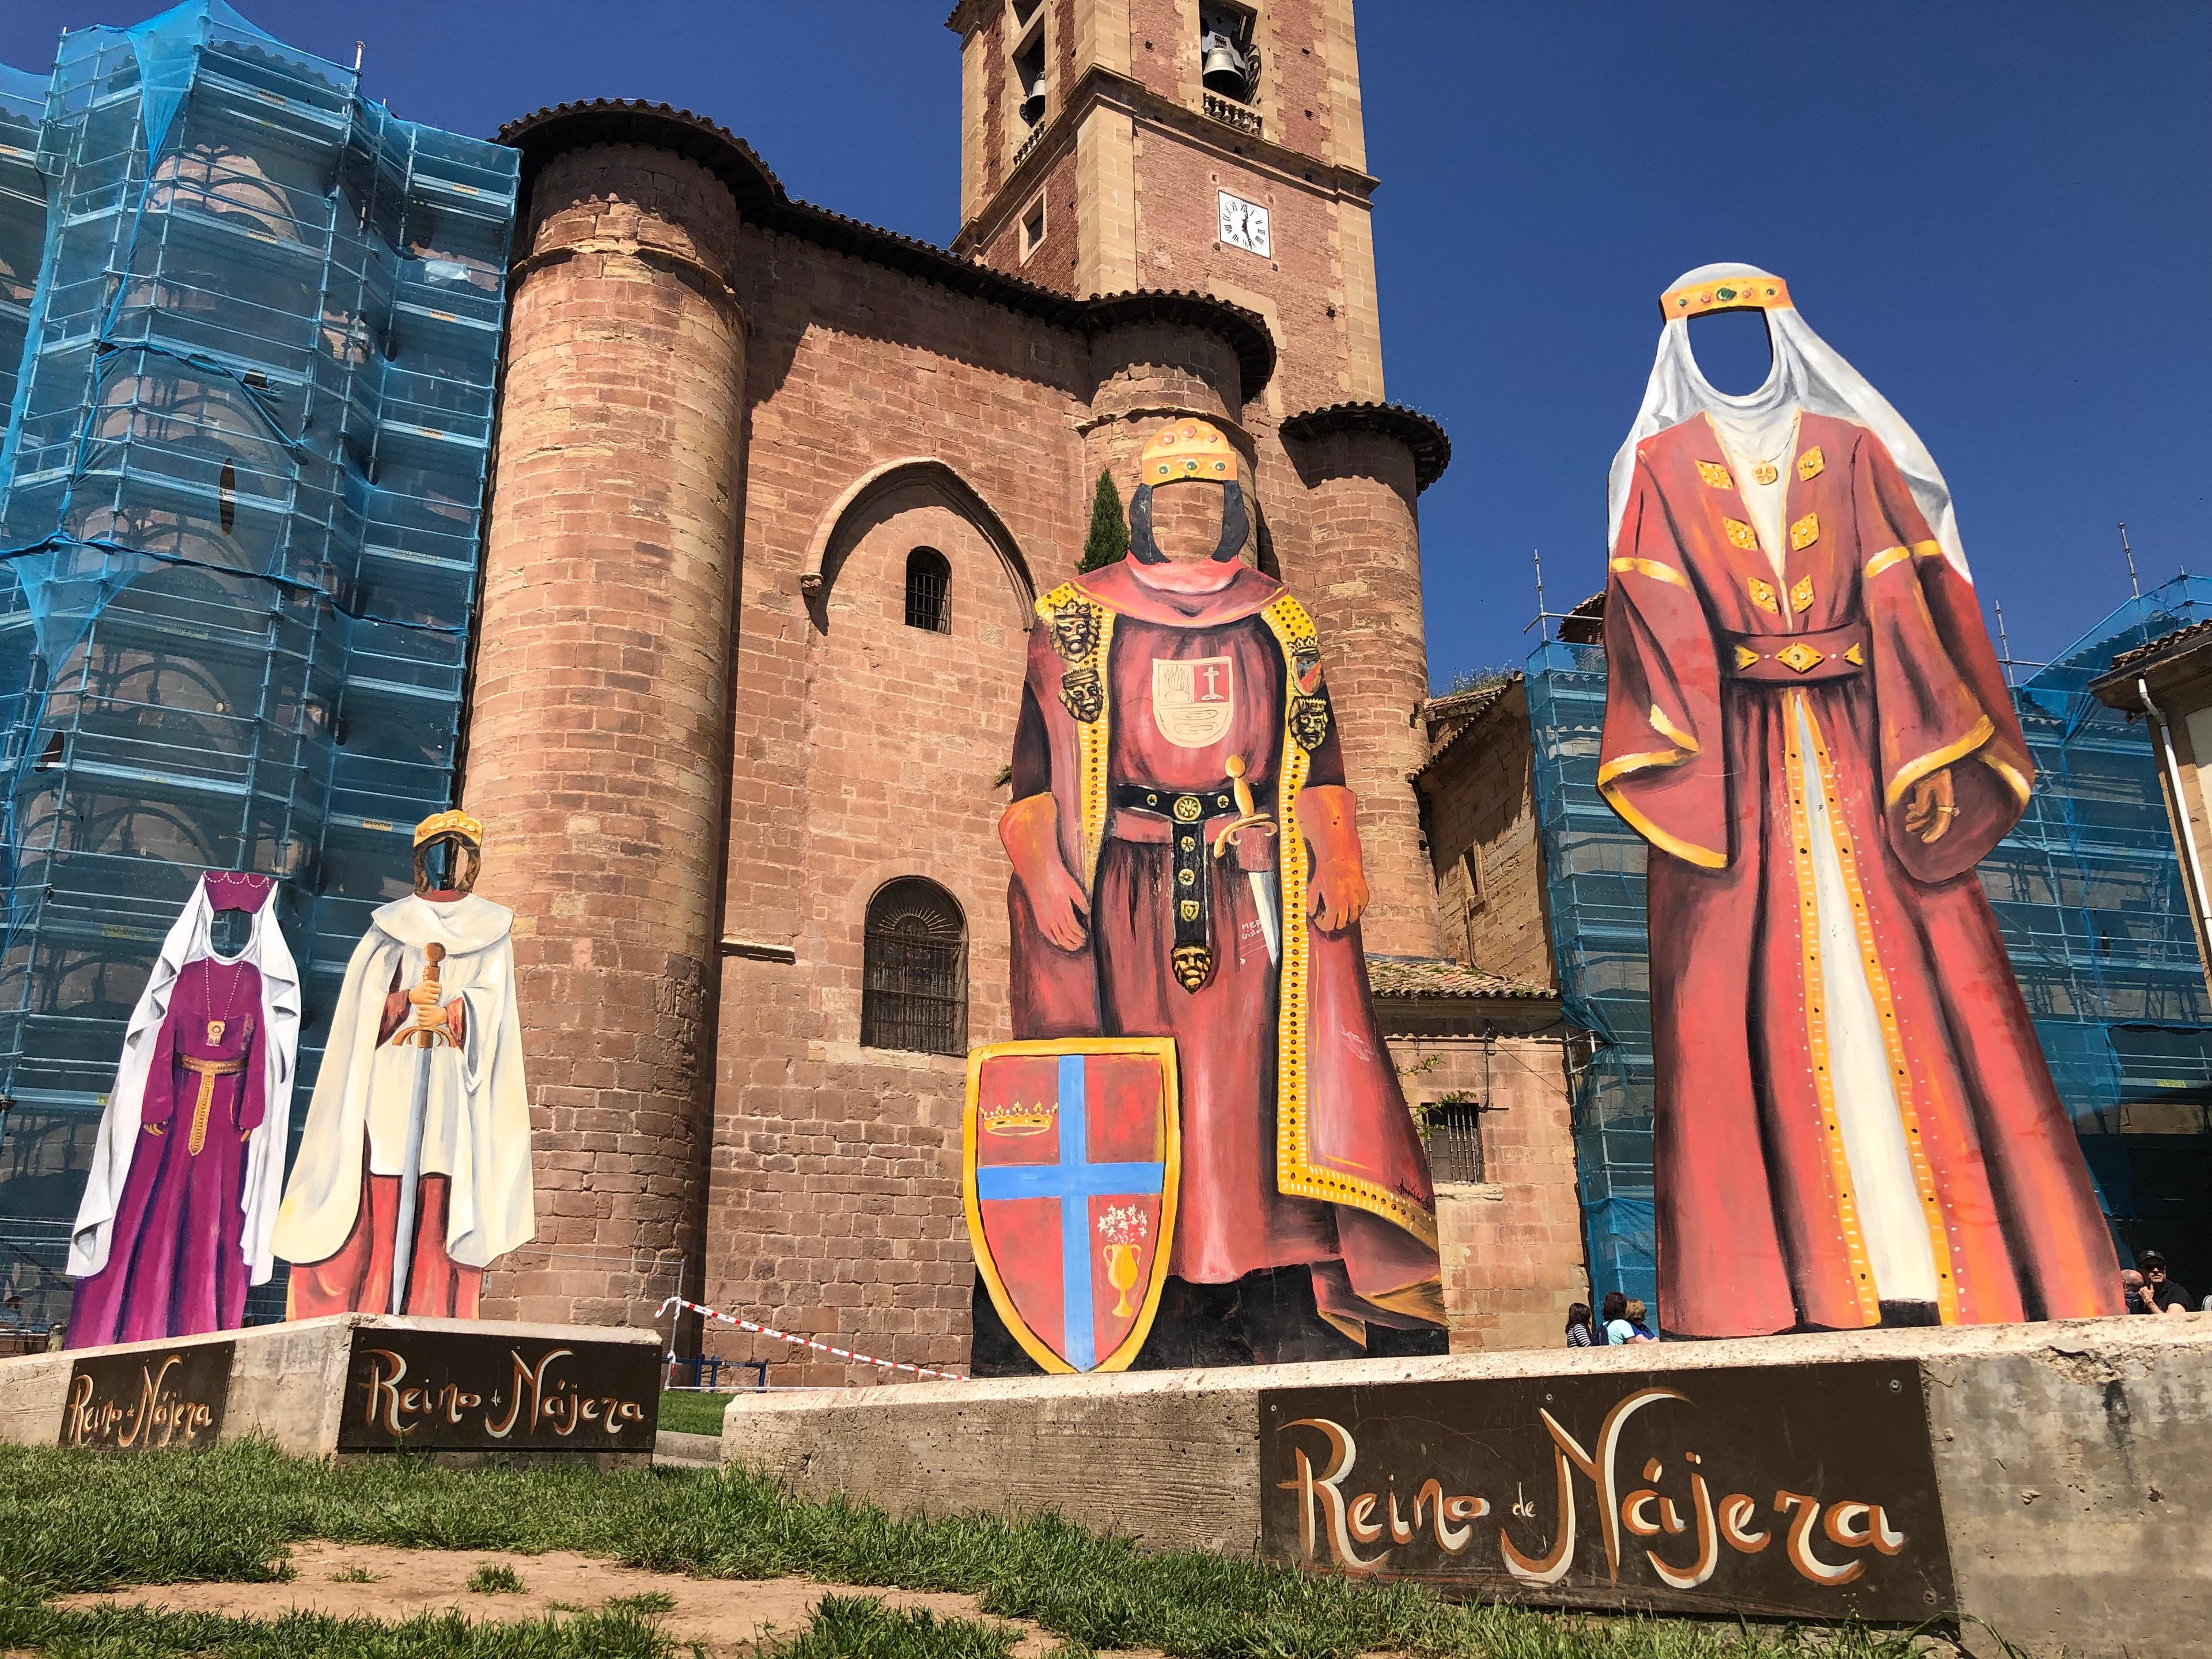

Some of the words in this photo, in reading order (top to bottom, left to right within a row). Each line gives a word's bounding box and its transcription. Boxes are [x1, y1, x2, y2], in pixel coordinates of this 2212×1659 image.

[69, 1374, 123, 1447] Reino
[118, 1354, 213, 1448] Nájera
[358, 1349, 482, 1437] Reino
[485, 1348, 644, 1438] Nájera
[491, 1389, 502, 1407] de
[1276, 1418, 1491, 1571] Reino
[1501, 1386, 1905, 1589] Nájera
[1512, 1482, 1537, 1518] de
